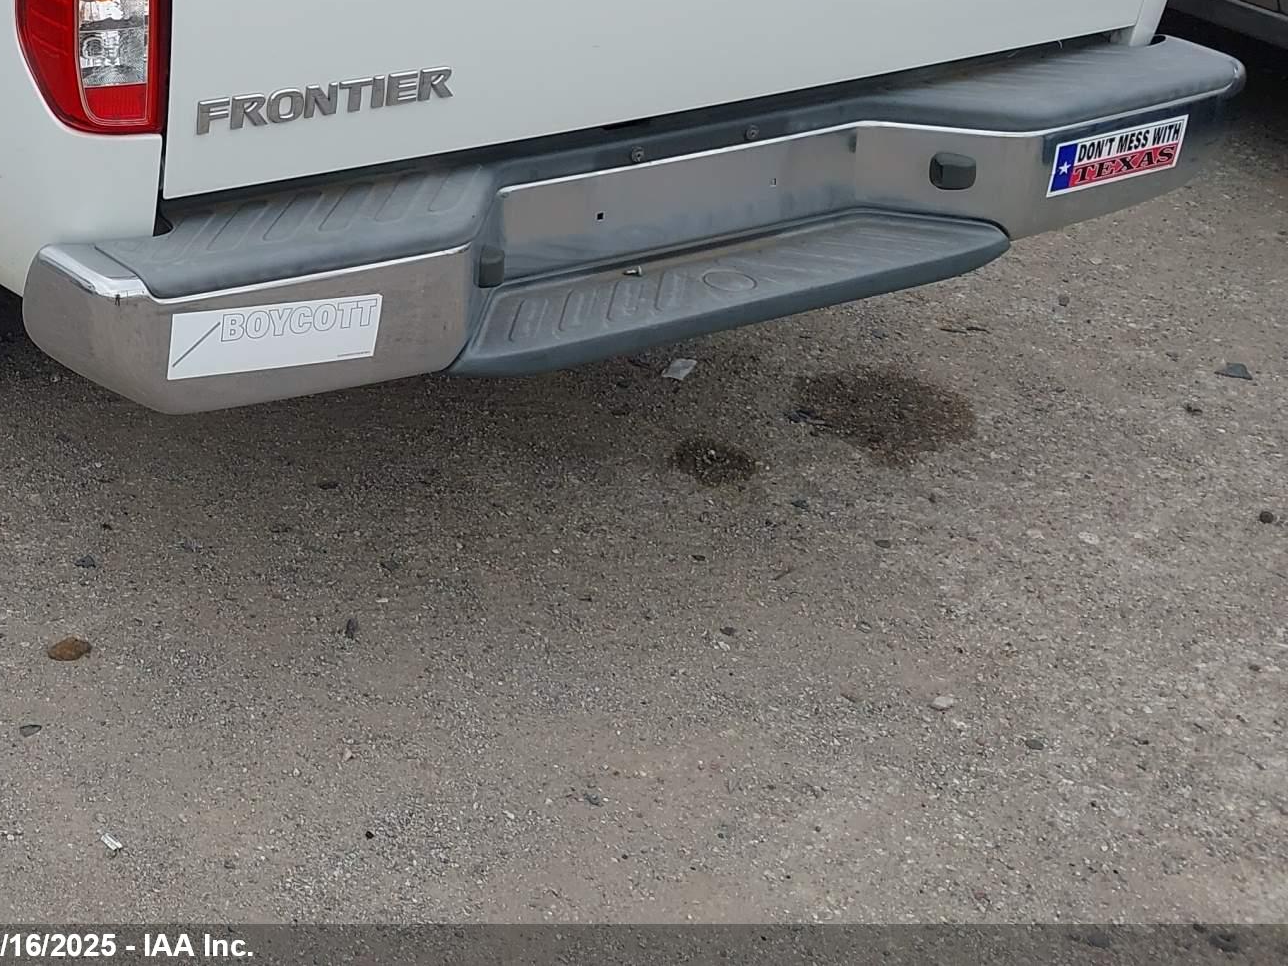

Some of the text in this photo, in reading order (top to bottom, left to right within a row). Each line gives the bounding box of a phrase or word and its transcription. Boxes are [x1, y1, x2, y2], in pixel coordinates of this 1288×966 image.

[196, 65, 453, 135] FRONTIER
[1078, 122, 1182, 163] DON'T MESS WITH
[1074, 146, 1175, 183] TEXAS
[221, 298, 377, 342] BOYCOTT
